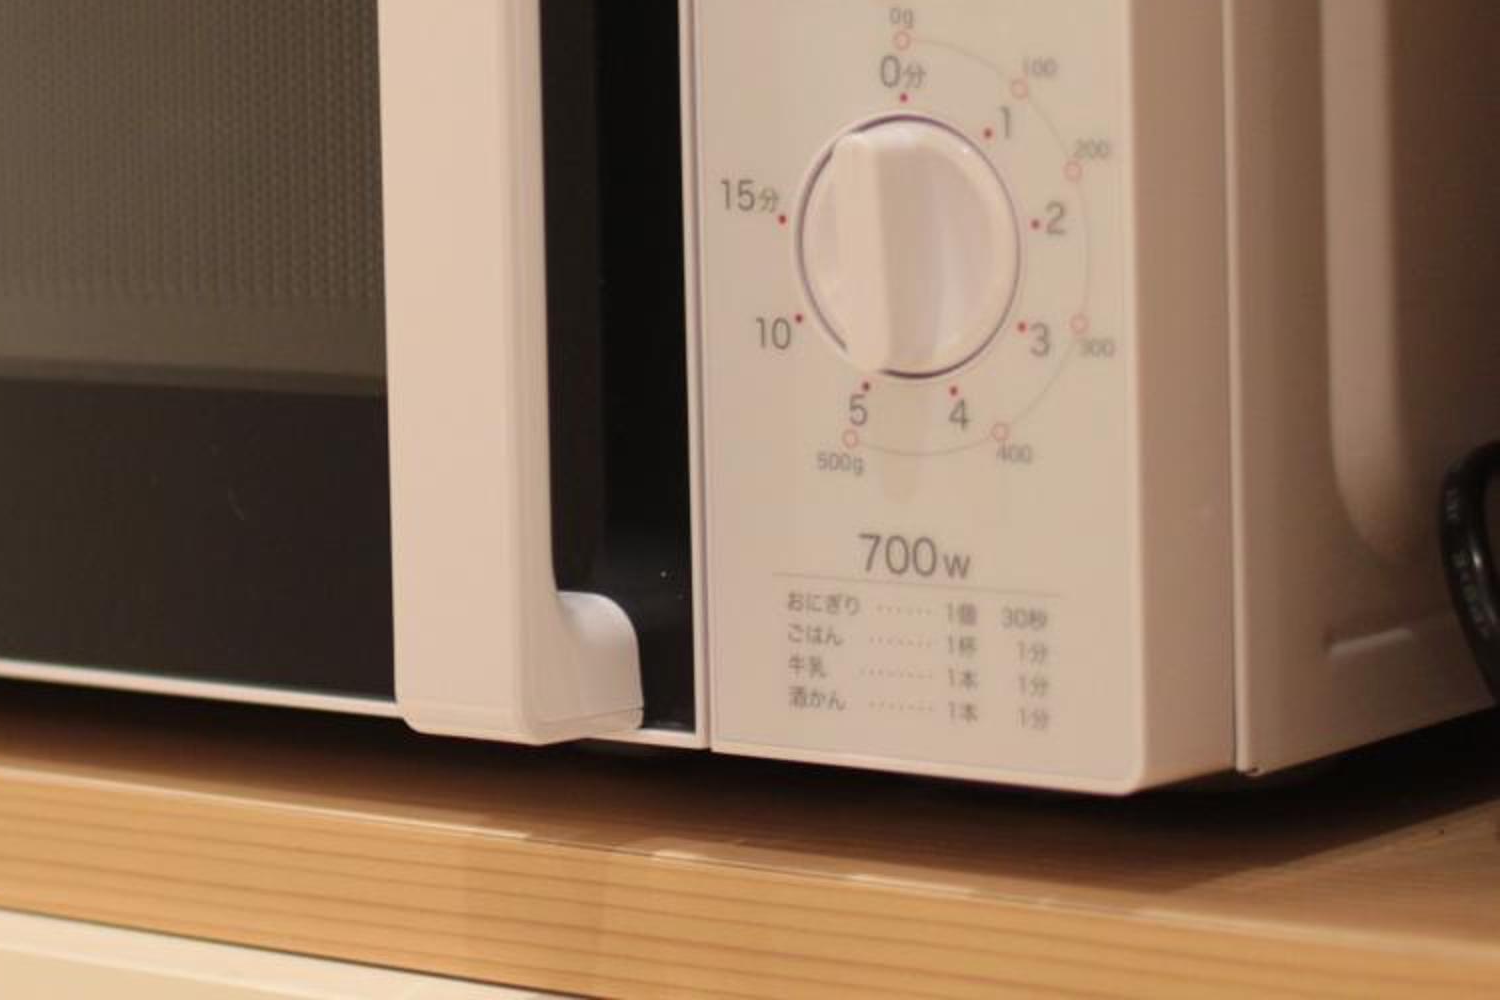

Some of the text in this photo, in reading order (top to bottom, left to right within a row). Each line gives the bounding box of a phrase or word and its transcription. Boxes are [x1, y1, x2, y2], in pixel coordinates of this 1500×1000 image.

[889, 7, 915, 29] 0g
[879, 54, 927, 88] 0分
[1021, 57, 1058, 78] 100
[999, 106, 1013, 139] 1
[1073, 139, 1111, 161] 200
[720, 178, 780, 214] 15分
[1044, 201, 1068, 237] 2
[754, 316, 792, 351] 10
[1029, 322, 1051, 357] 3
[1078, 336, 1115, 359] 300
[848, 394, 869, 427] 5
[947, 398, 970, 431] 4
[816, 452, 865, 477] 500g
[995, 443, 1033, 465] 400
